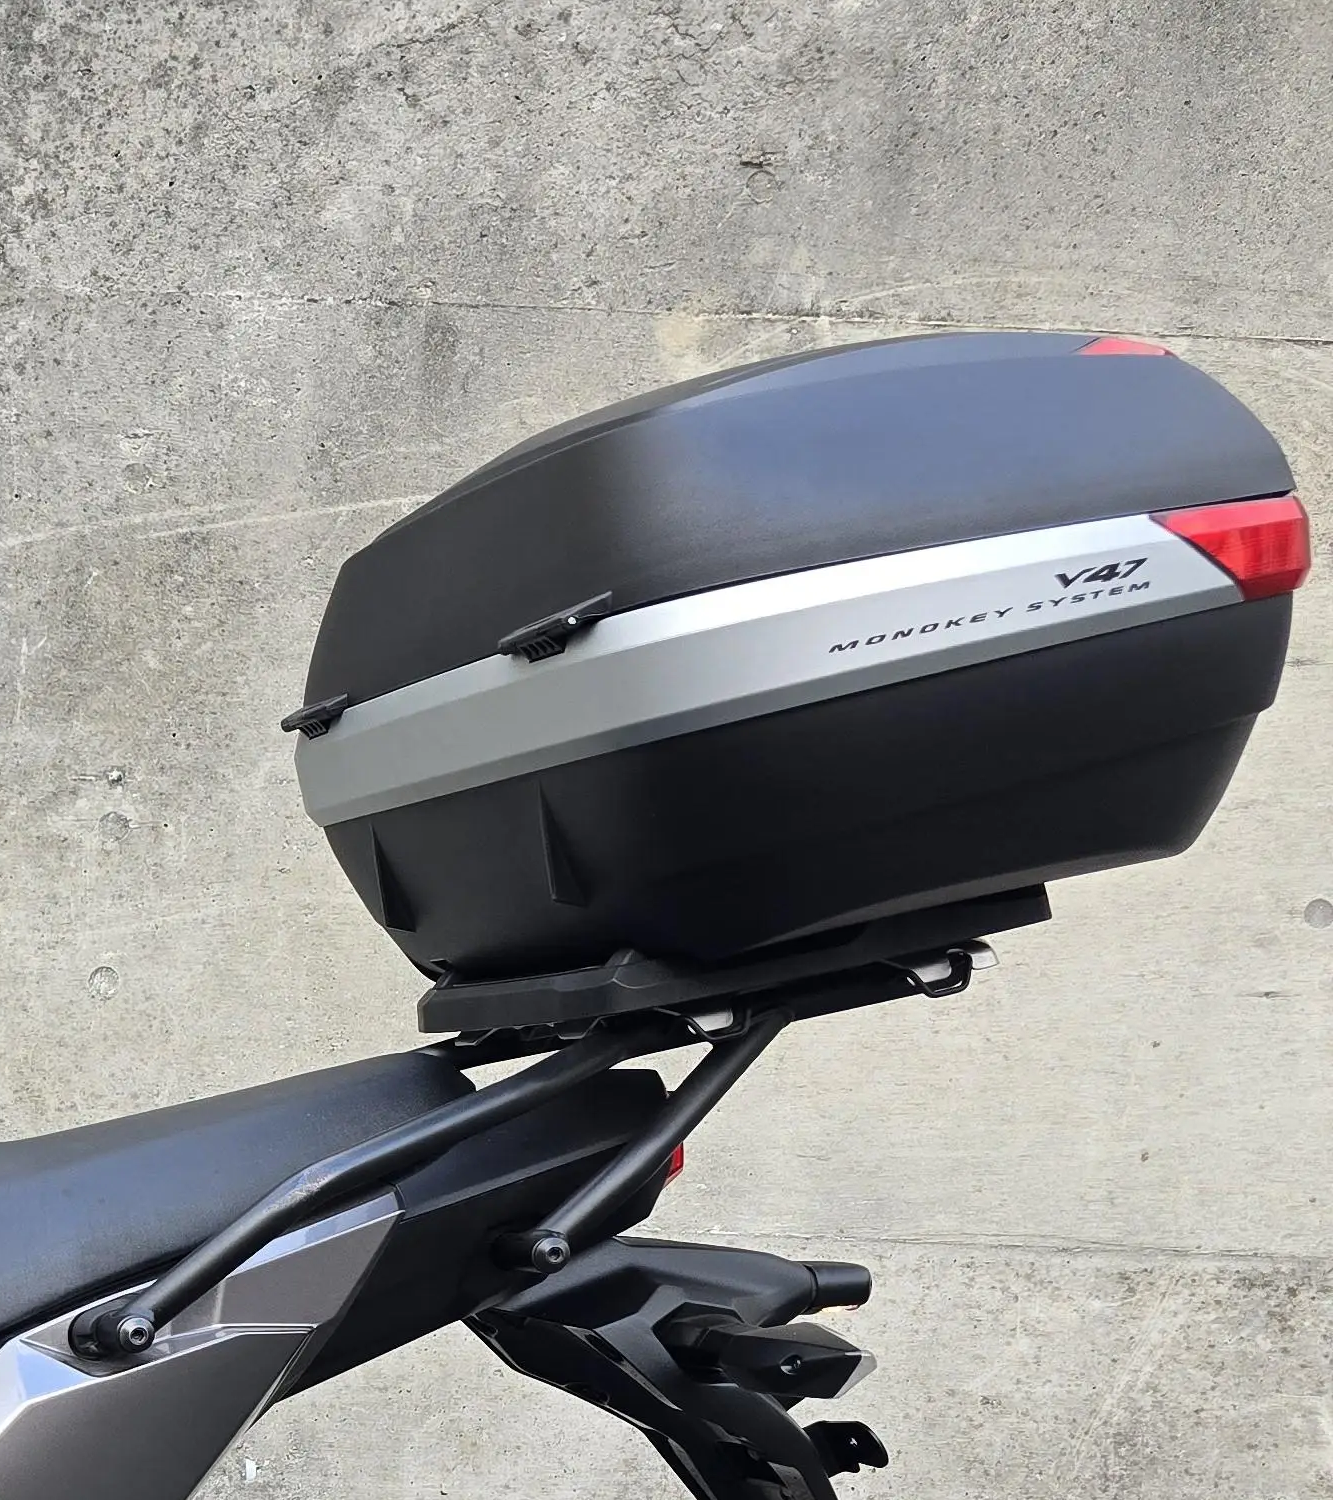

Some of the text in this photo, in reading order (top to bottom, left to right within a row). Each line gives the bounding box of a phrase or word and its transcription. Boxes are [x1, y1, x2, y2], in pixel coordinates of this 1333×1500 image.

[1054, 557, 1148, 589] V47
[828, 580, 1152, 655] MONOKEY SYSTEM
